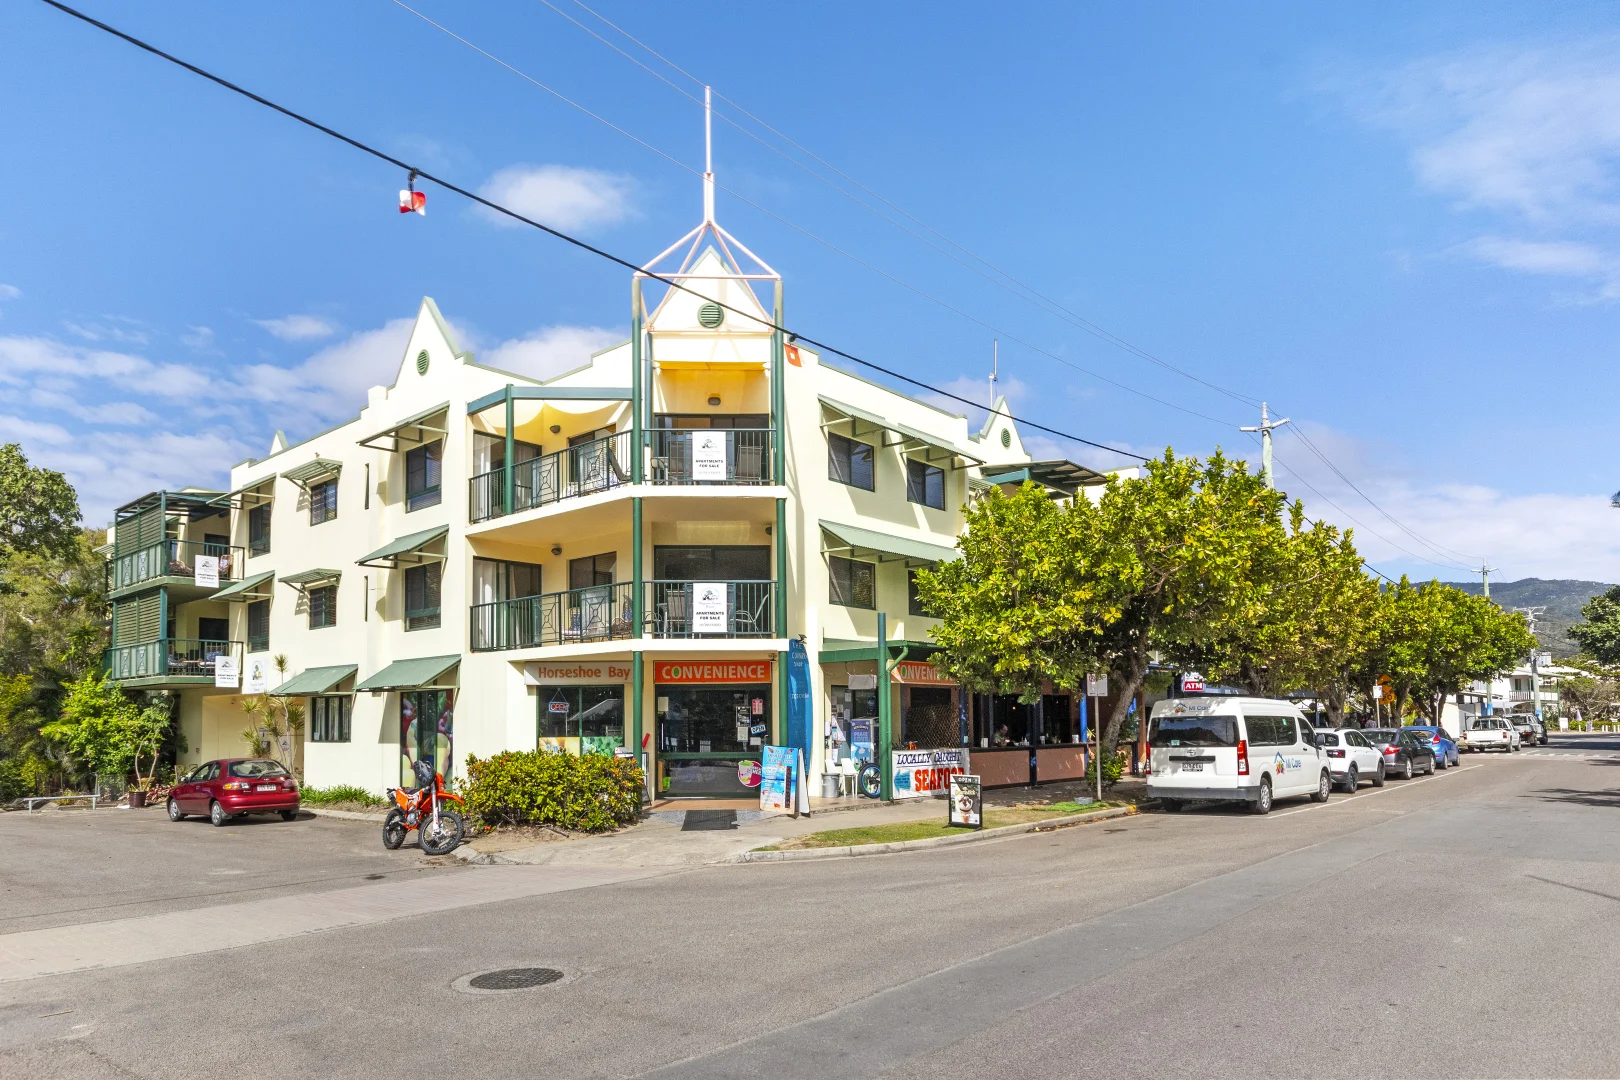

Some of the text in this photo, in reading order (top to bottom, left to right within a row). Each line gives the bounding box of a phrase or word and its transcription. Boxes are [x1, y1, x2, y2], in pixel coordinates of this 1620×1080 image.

[538, 665, 631, 680] Horseshoe Bay
[661, 665, 765, 679] CONVENIENCE
[550, 703, 568, 711] OPEN
[752, 725, 765, 733] OPEN
[896, 751, 962, 765] LOCALLY CAUGHT
